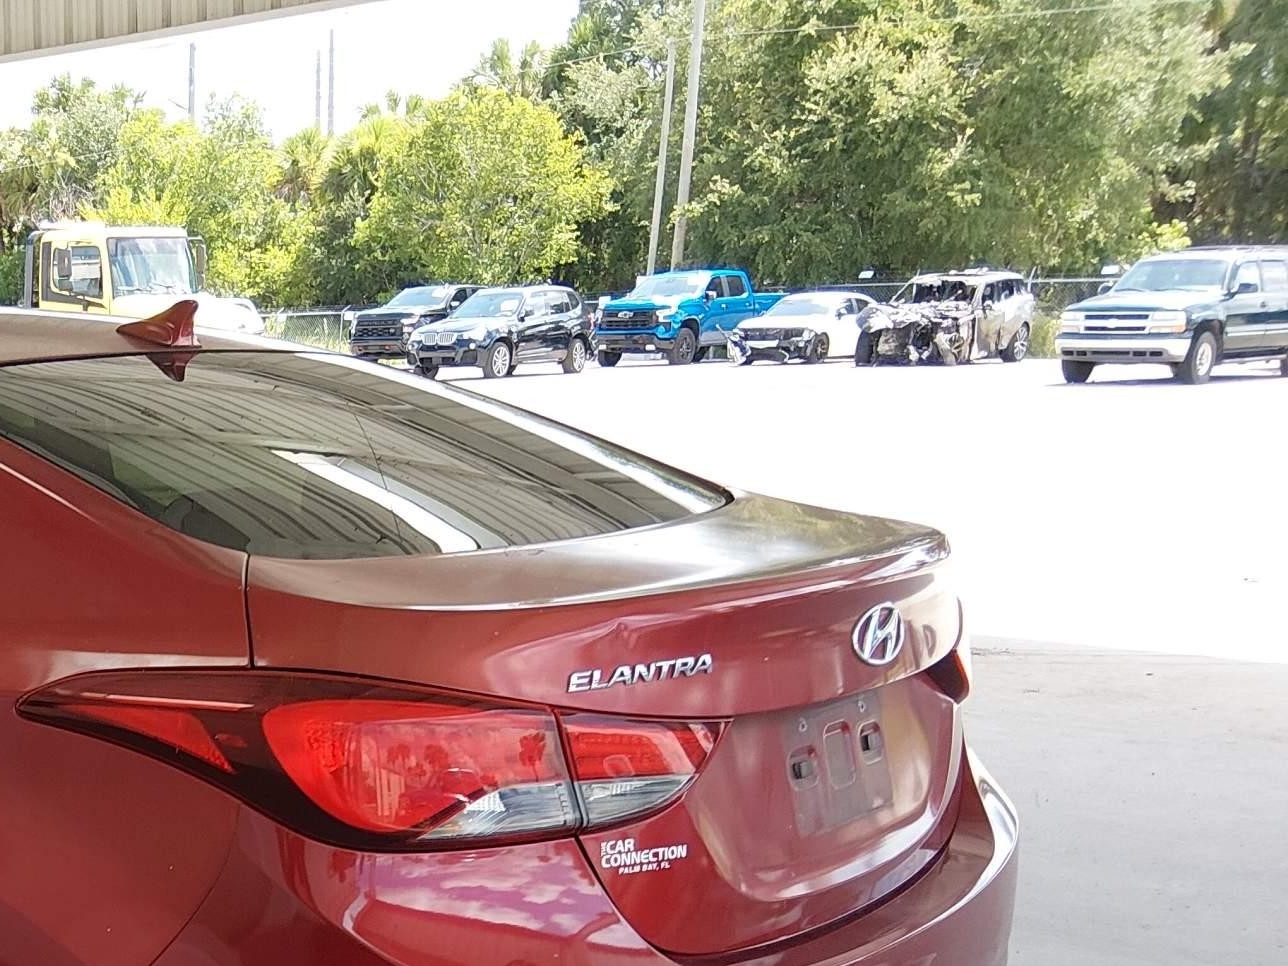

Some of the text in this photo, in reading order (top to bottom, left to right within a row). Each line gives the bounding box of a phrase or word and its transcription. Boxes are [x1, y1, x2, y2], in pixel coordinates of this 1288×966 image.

[567, 653, 713, 693] ELANTRA
[601, 844, 688, 868] CONNECTION
[606, 838, 635, 854] CAR
[618, 861, 671, 875] PALM BAY, FL
